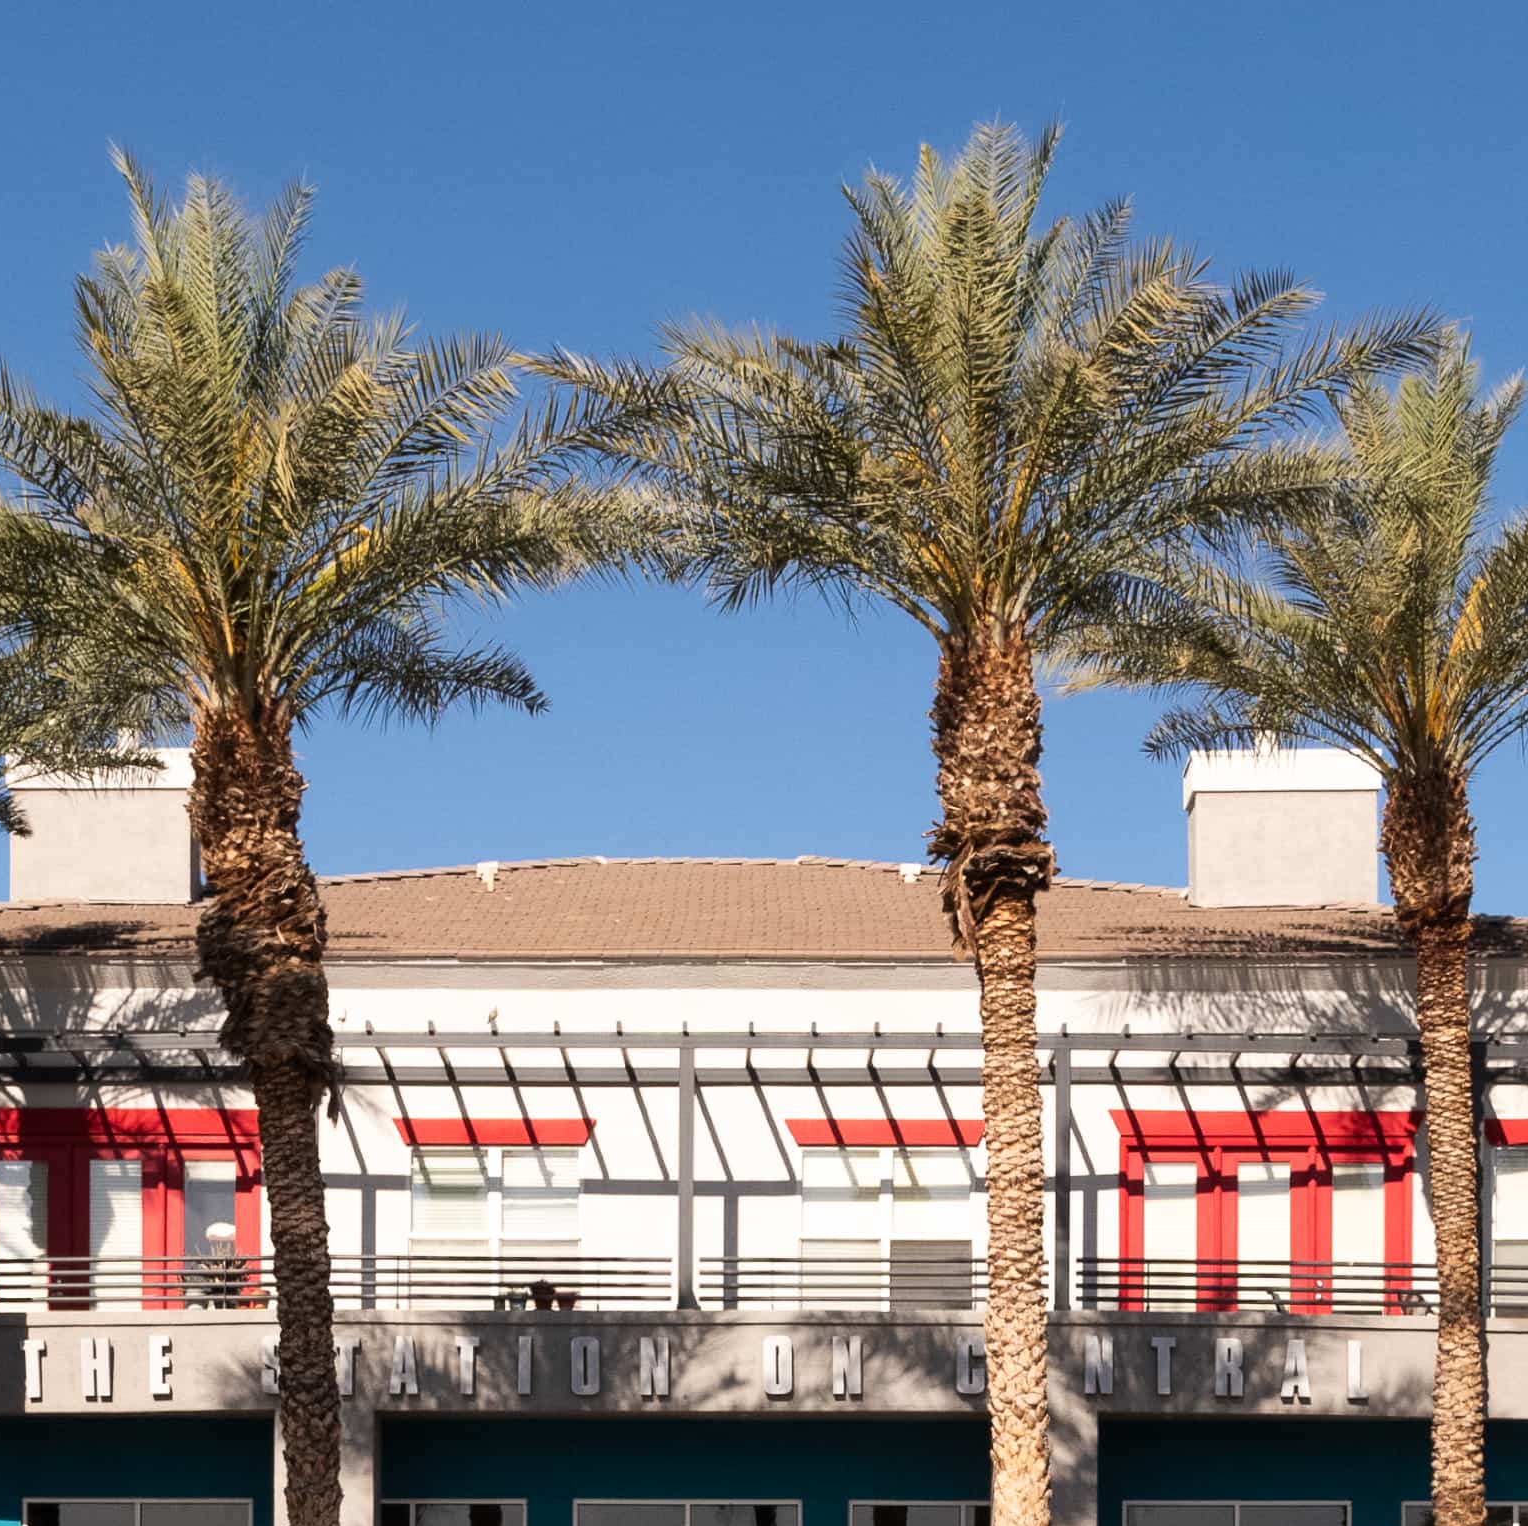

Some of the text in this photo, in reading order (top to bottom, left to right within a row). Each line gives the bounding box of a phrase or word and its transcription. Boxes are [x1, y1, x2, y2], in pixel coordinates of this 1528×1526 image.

[24, 1334, 1369, 1401] THE STATION ON CNTRAL
